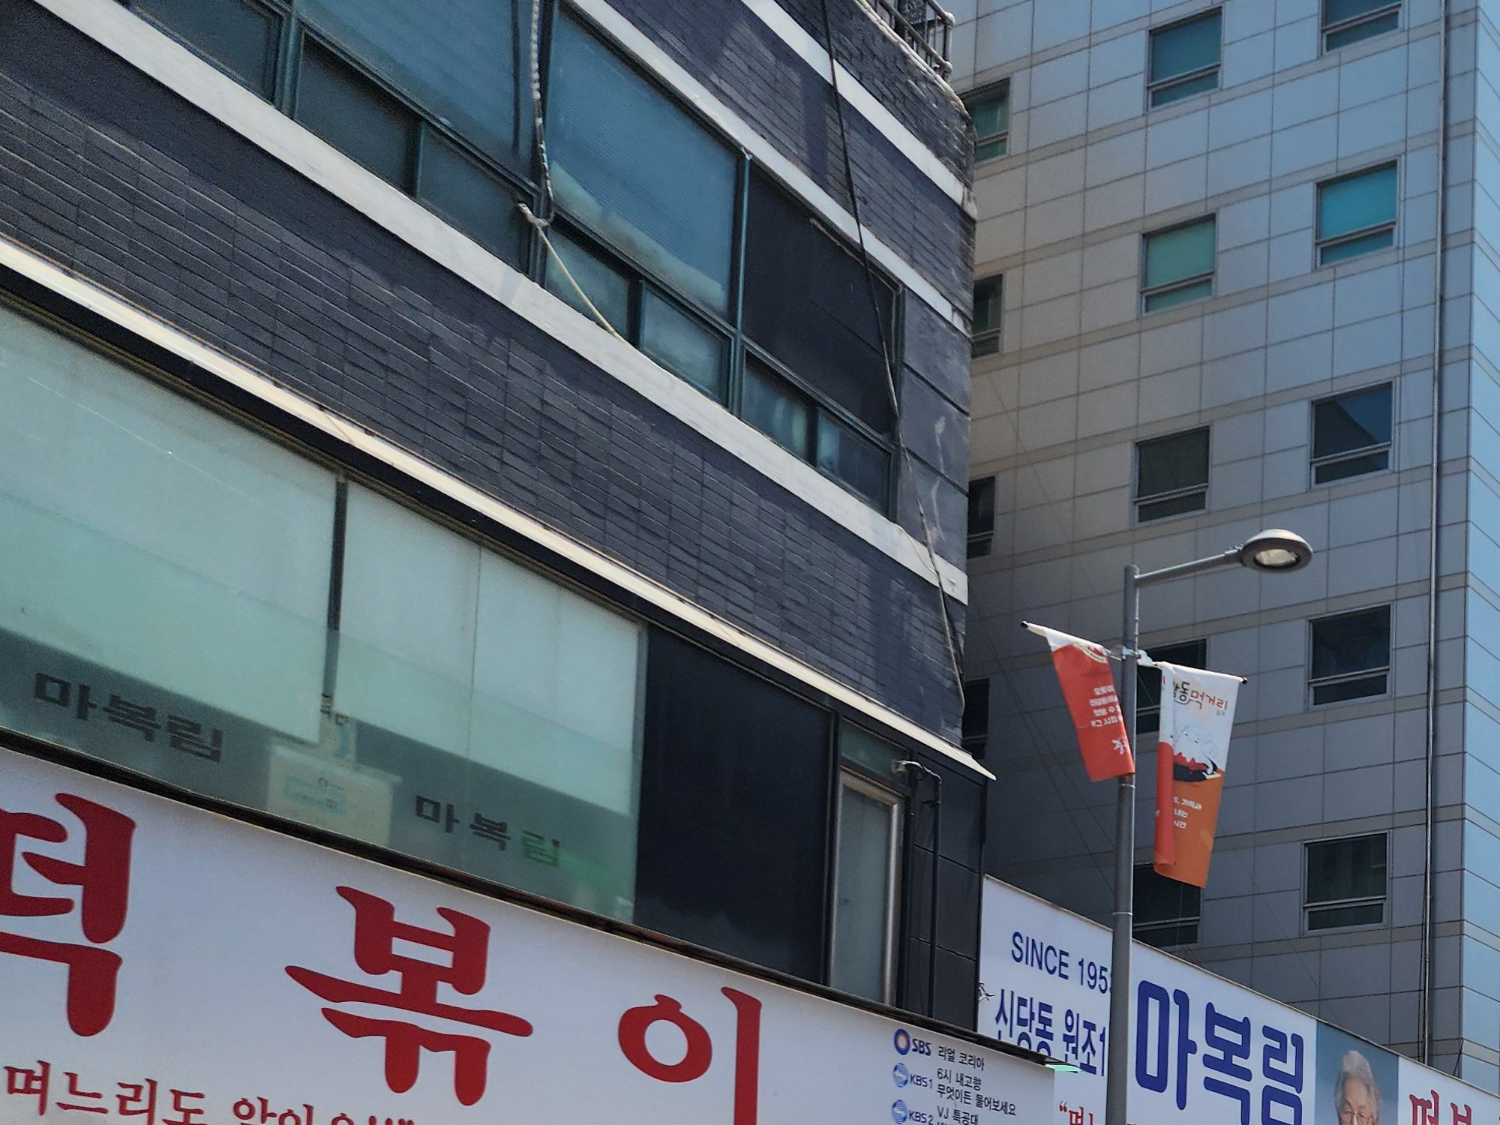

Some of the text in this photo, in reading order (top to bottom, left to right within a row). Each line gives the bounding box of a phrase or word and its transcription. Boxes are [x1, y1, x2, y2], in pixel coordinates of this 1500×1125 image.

[34, 671, 224, 764] 마복림
[414, 793, 562, 867] 마복림
[1011, 931, 1112, 994] SINCE 195
[912, 1038, 985, 1071] SBS 리얼 코리아
[937, 1067, 952, 1083] 6시
[956, 1073, 982, 1091] 내고향
[937, 1084, 1017, 1116] 무엇이든 물어보세요
